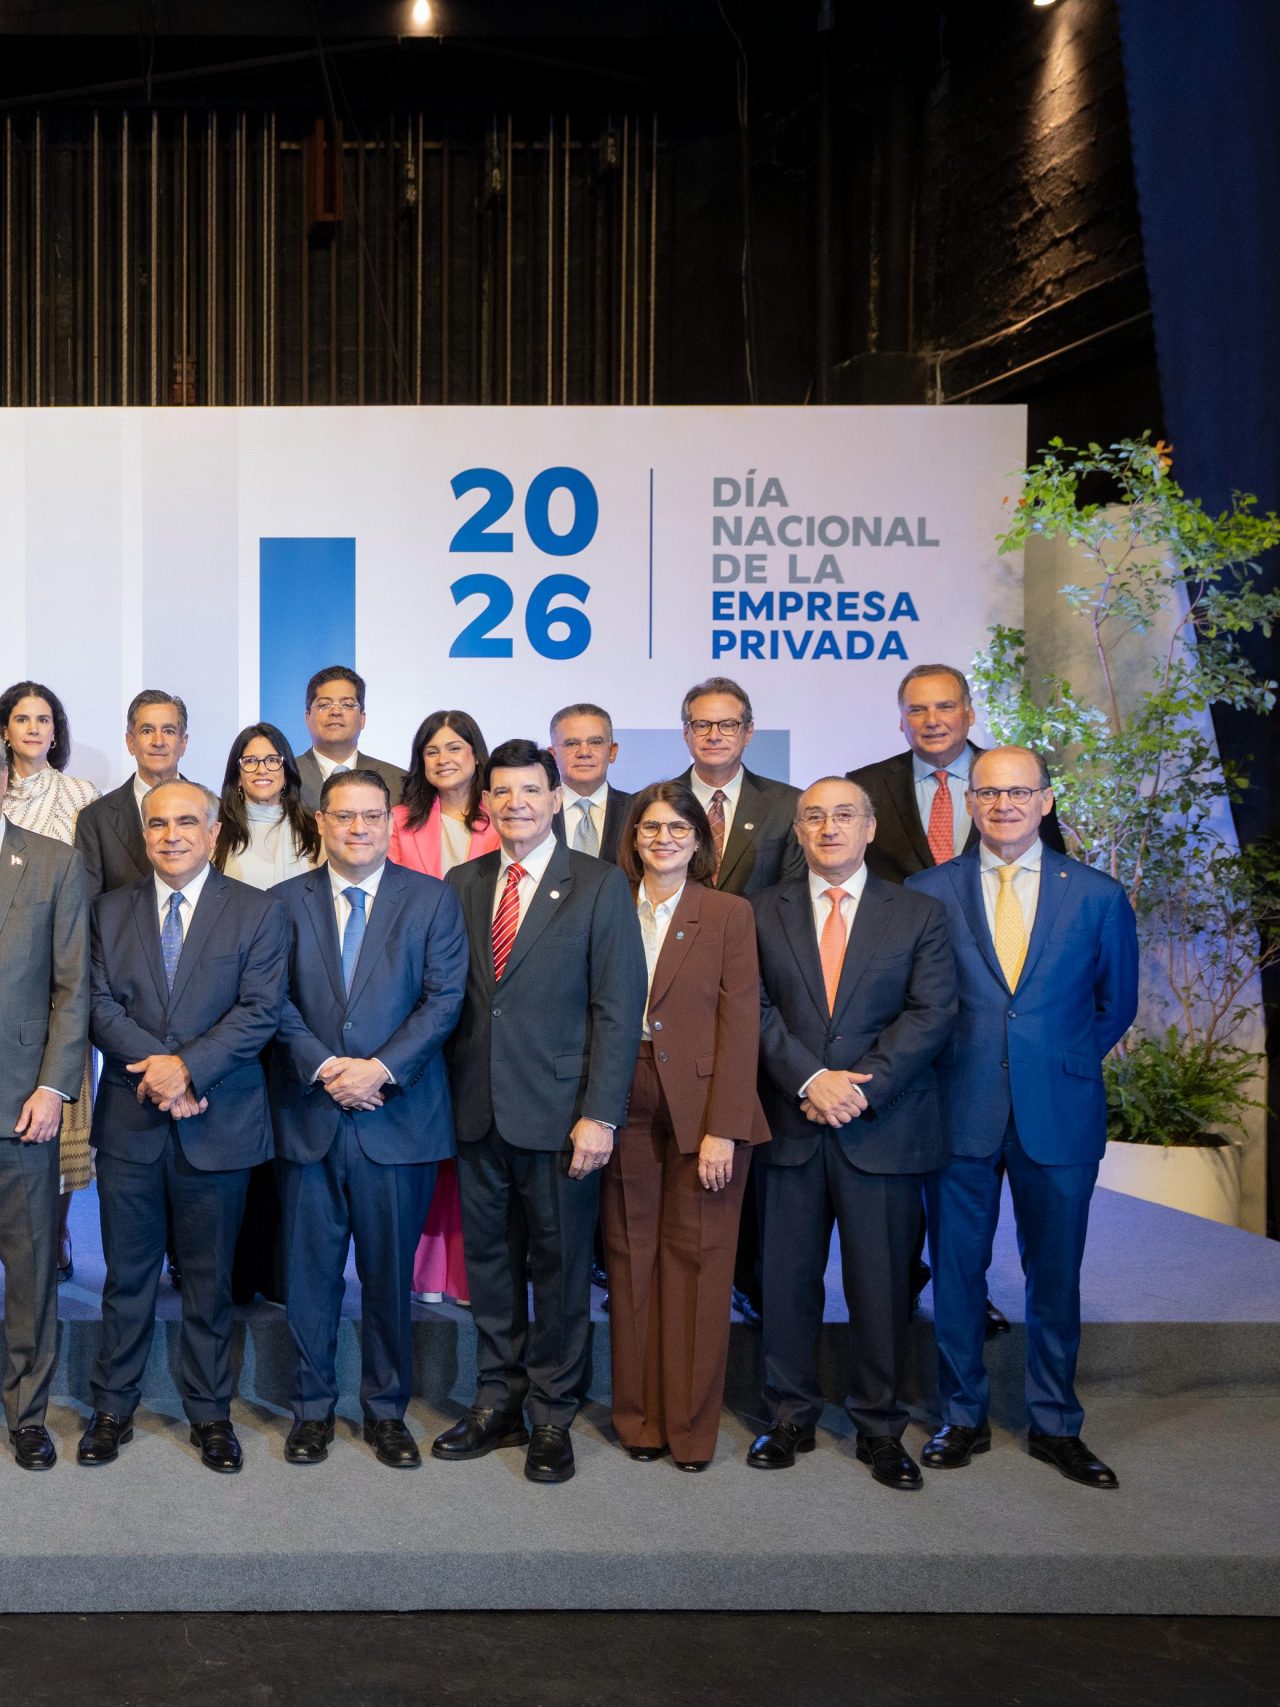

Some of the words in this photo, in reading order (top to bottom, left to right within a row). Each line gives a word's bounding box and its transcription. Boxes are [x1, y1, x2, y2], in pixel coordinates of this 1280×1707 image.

[713, 469, 789, 507] DÍA
[449, 467, 599, 556] 20
[713, 515, 940, 547] NACIONAL
[713, 554, 768, 584] DE
[789, 554, 845, 584] LA
[449, 574, 592, 660] 26
[713, 591, 919, 622] EMPRESA
[712, 630, 909, 660] PRIVADA
